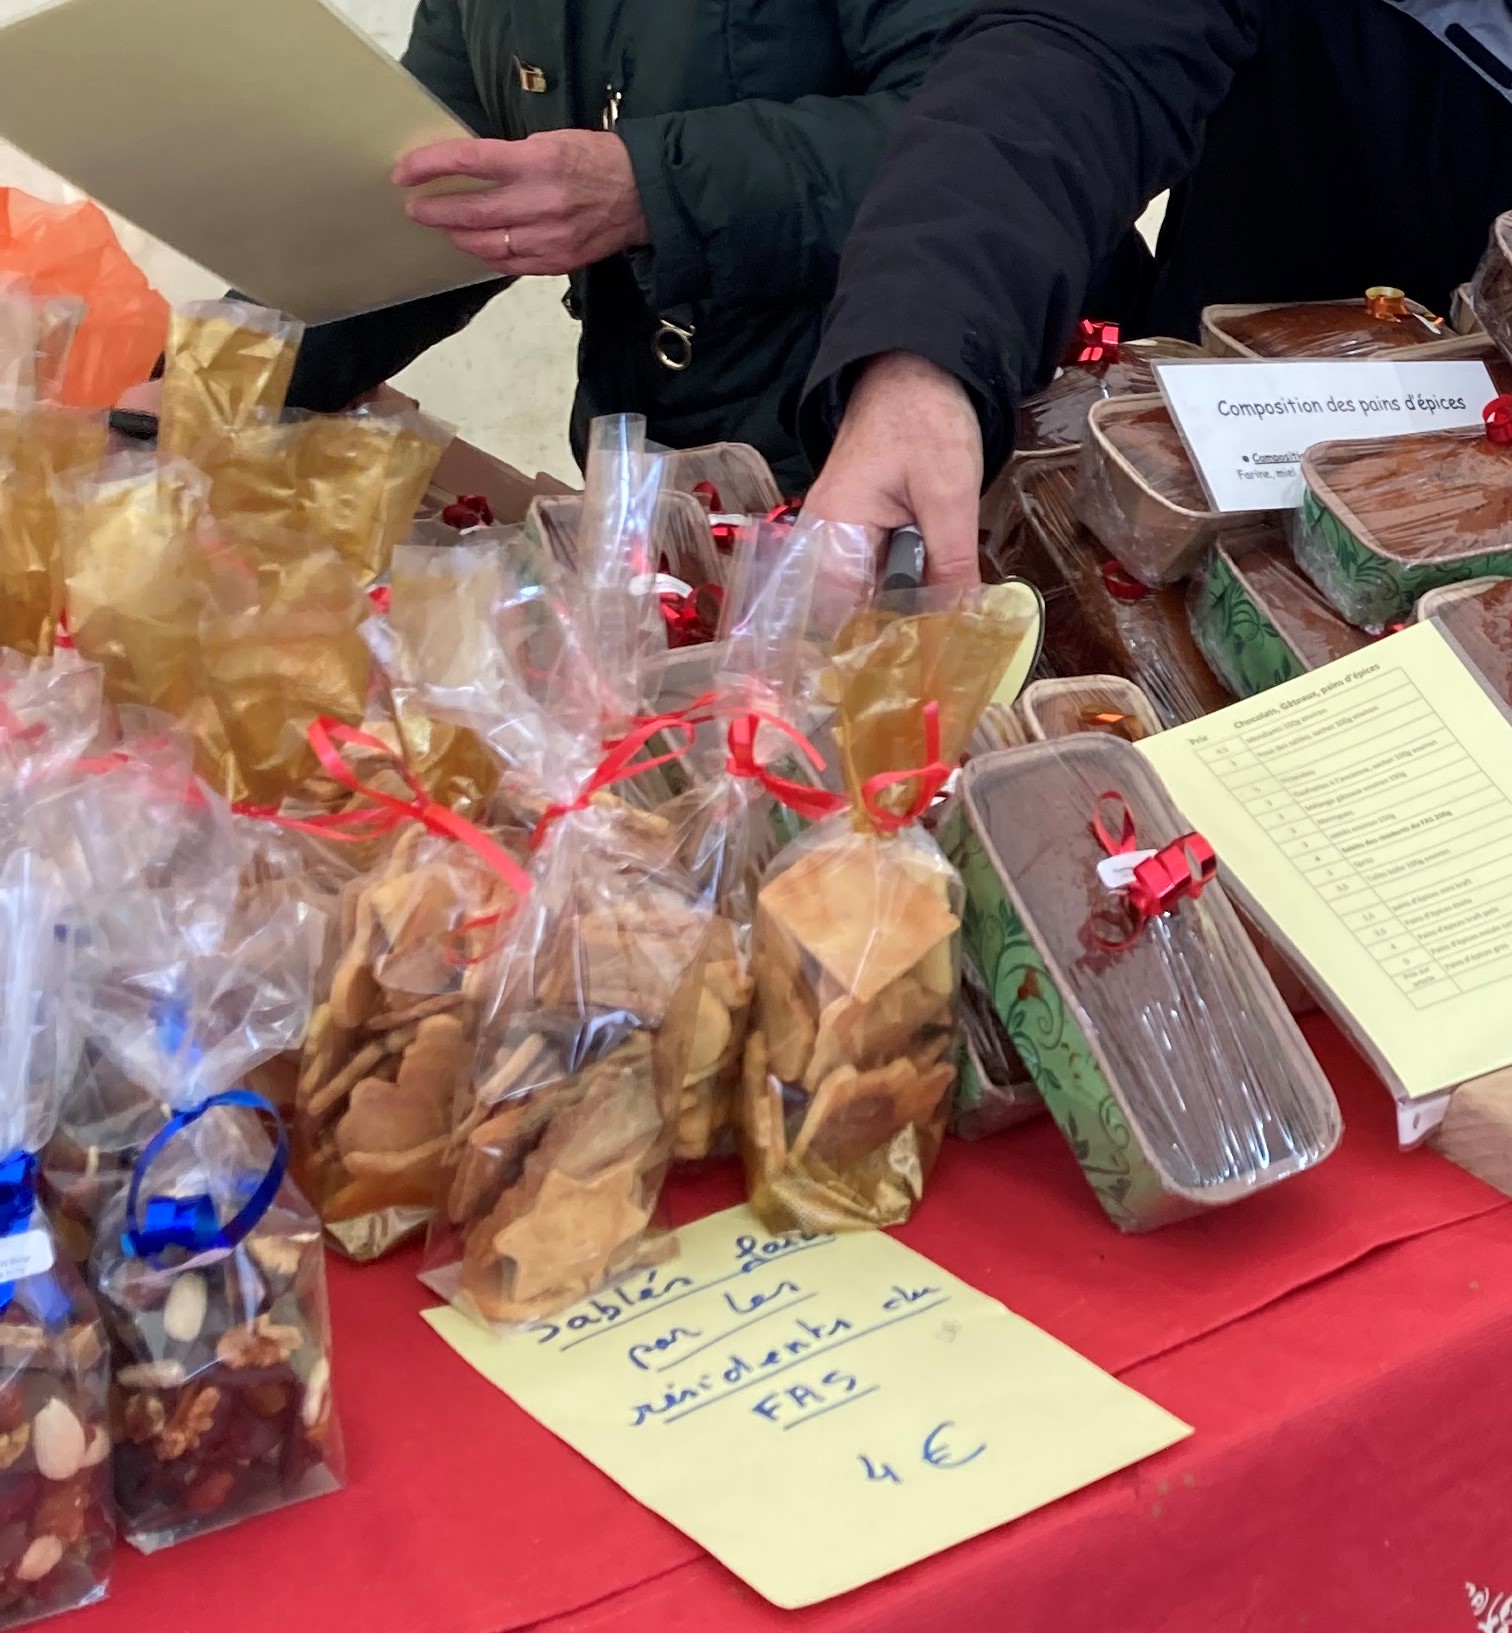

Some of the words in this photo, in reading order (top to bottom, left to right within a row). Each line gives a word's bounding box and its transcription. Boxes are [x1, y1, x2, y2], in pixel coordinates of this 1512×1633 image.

[1218, 397, 1322, 420] Composition
[1328, 396, 1354, 413] des
[1359, 394, 1401, 416] pains
[1404, 393, 1466, 413] d'épices
[1252, 450, 1304, 465] Compositi
[1276, 466, 1296, 478] miel
[1234, 708, 1281, 728] Chocolats,
[1280, 691, 1320, 710] Gâteaux,
[1320, 680, 1345, 694] pains
[1344, 664, 1380, 682] d'épices
[1189, 736, 1208, 745] Prix
[1420, 816, 1435, 825] FAS
[628, 1327, 702, 1371] par
[723, 1281, 800, 1314] les
[629, 1318, 854, 1426] résidents
[882, 1285, 941, 1310] du
[751, 1370, 857, 1421] FAS
[856, 1453, 903, 1484] 4
[920, 1420, 988, 1470] €
